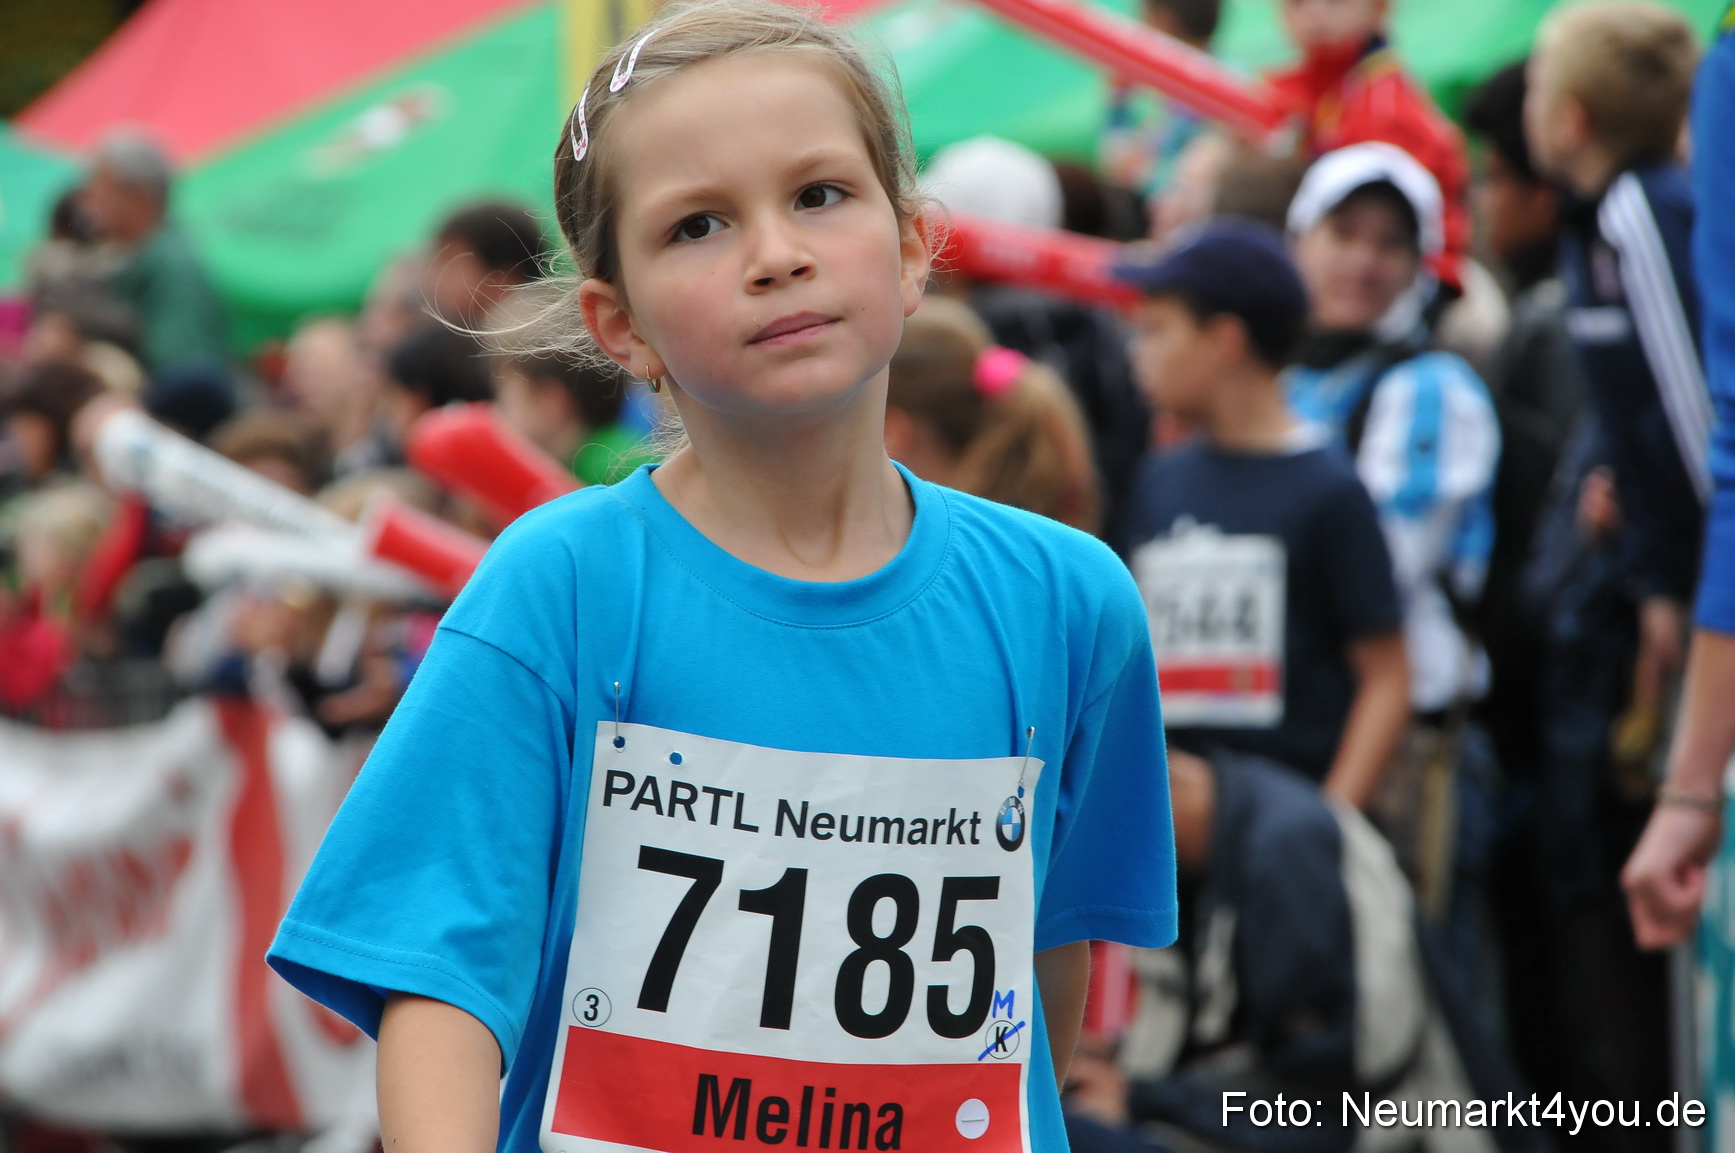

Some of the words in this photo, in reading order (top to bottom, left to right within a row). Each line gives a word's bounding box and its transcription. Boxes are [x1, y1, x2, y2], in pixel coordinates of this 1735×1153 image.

[602, 769, 759, 833] PARTL
[774, 799, 981, 846] Neumarkt
[637, 844, 1001, 1040] 7185
[583, 994, 599, 1022] 3
[992, 989, 1015, 1019] M
[691, 1073, 904, 1151] Melina
